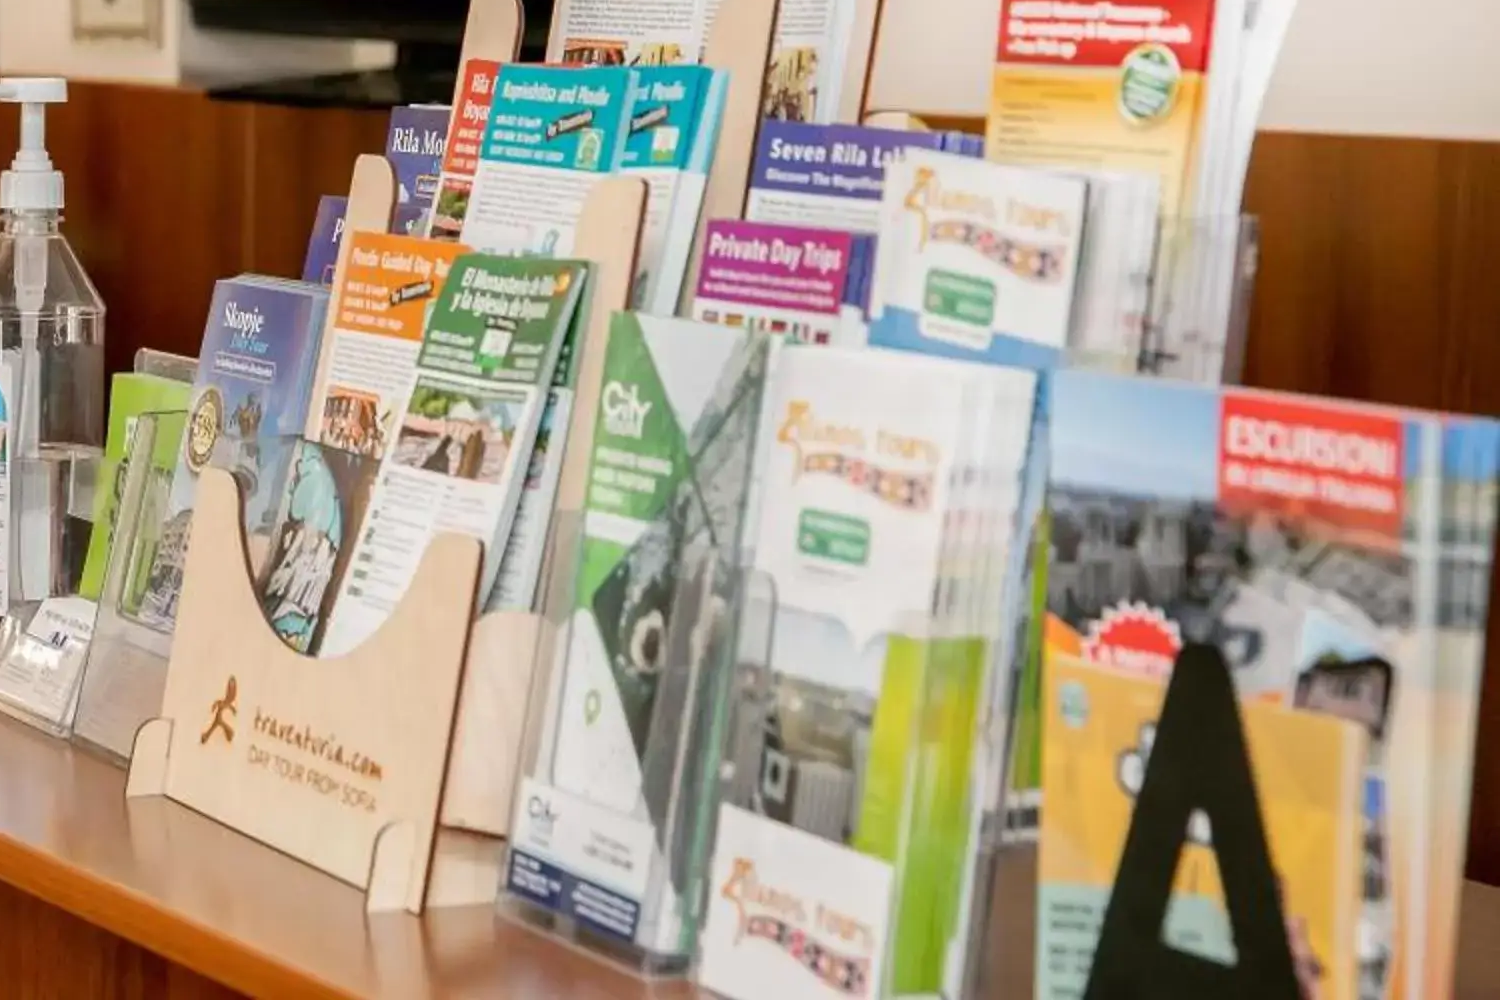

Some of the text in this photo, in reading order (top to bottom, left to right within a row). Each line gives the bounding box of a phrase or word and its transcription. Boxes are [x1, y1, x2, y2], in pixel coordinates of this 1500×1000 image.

[392, 127, 419, 153] Rila
[421, 130, 445, 156] Mo
[769, 137, 827, 163] Seven
[831, 142, 867, 167] Rila
[708, 231, 843, 275] Private Day Trips
[461, 291, 472, 309] la
[223, 301, 265, 338] Skopje
[254, 707, 384, 781] traventuria.com
[247, 745, 377, 812] DAY TOUR FROM SOFIA
